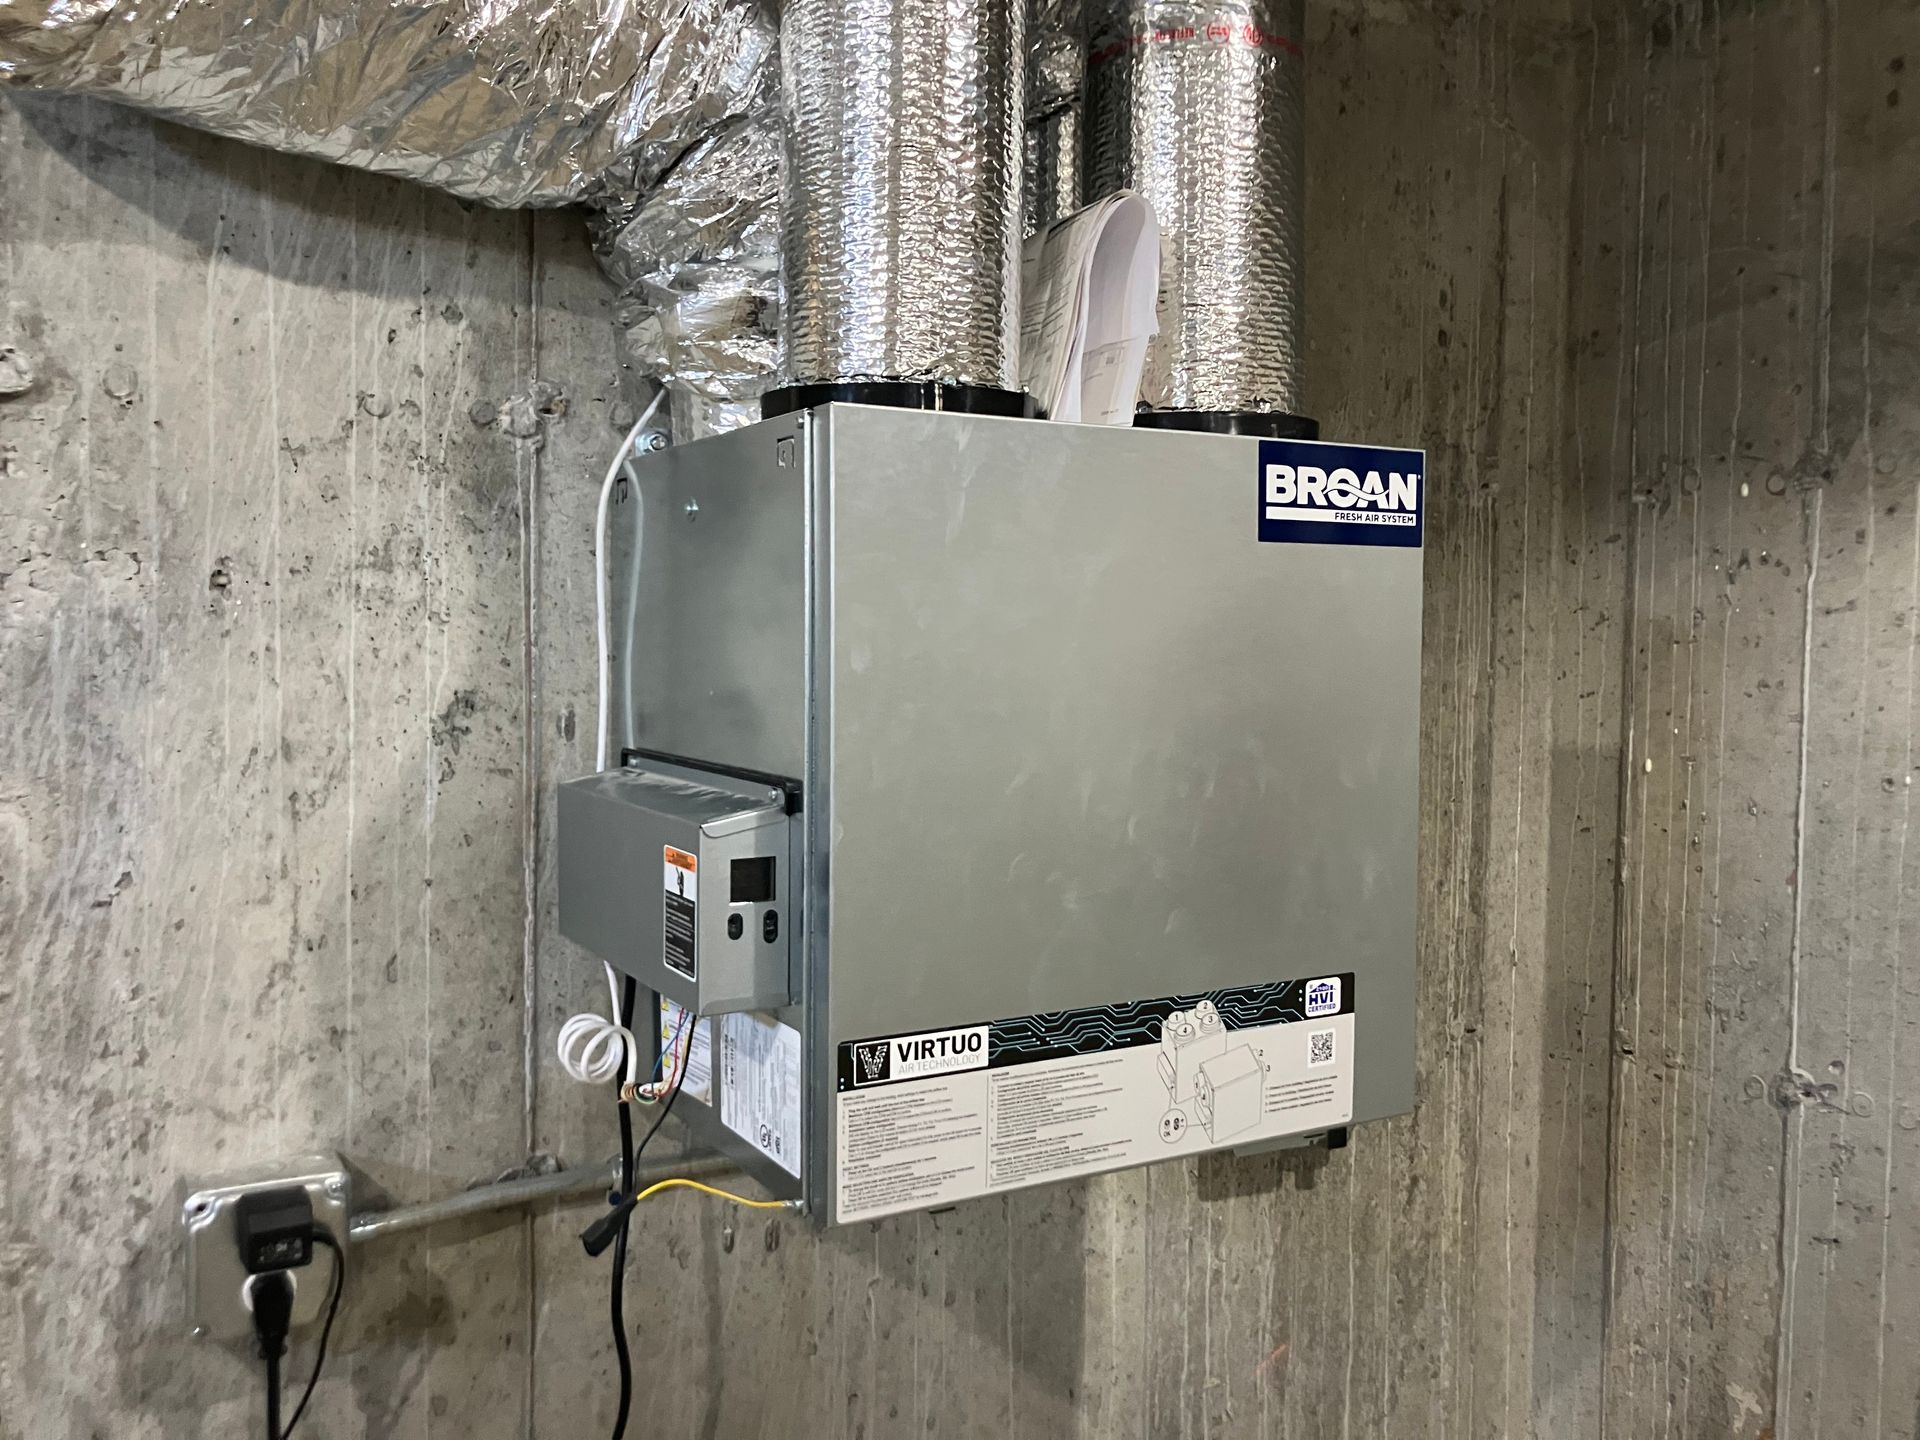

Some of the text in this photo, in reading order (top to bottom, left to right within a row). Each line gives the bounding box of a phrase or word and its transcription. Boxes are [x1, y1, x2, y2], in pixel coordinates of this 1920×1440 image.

[1265, 463, 1418, 511] BROAN
[1334, 512, 1414, 524] FRESH AIR SYSTEM
[1308, 991, 1334, 1006] HVI
[897, 1032, 982, 1063] VIRTUO
[898, 1053, 982, 1075] AIR TECHNOLOGY
